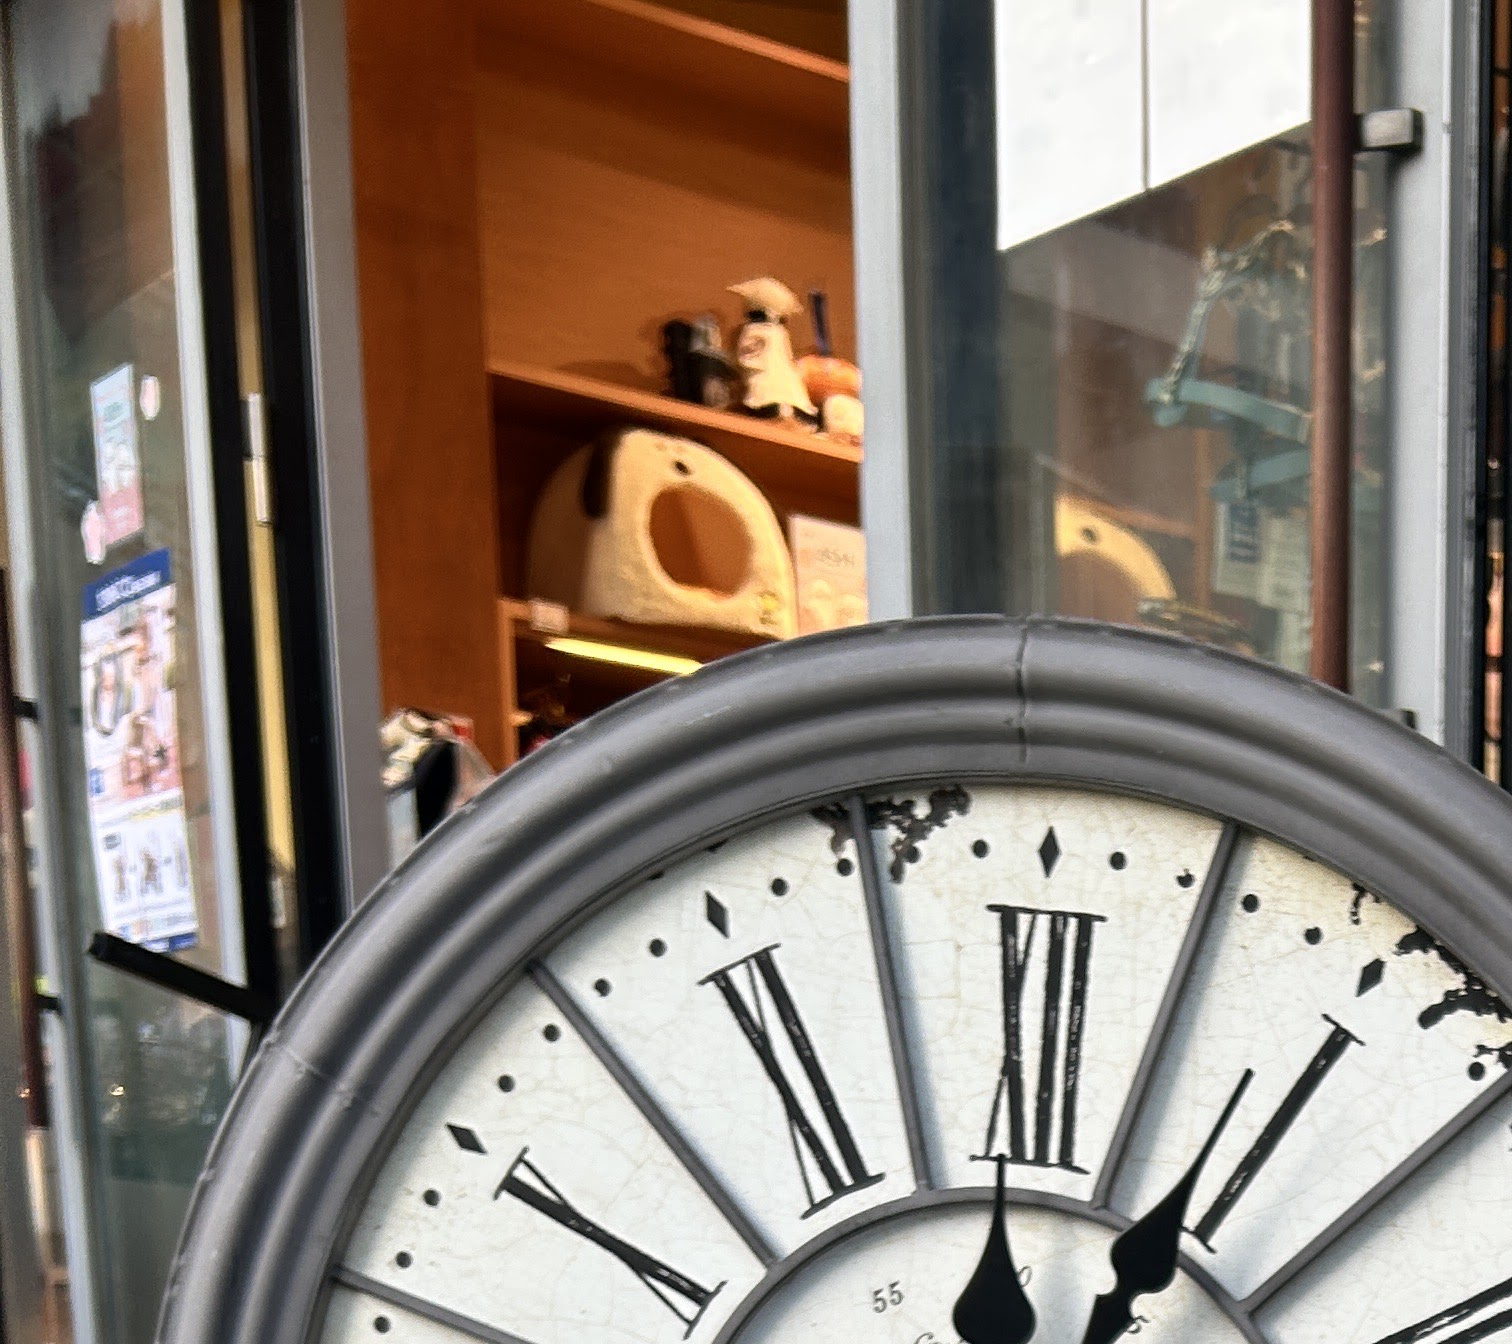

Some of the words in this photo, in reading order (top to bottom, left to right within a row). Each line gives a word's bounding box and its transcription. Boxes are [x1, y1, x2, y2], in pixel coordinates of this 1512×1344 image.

[696, 942, 886, 1220] XI
[969, 903, 1107, 1175] XII
[1180, 1013, 1366, 1253] I
[493, 1146, 728, 1340] X
[871, 1280, 905, 1314] 55
